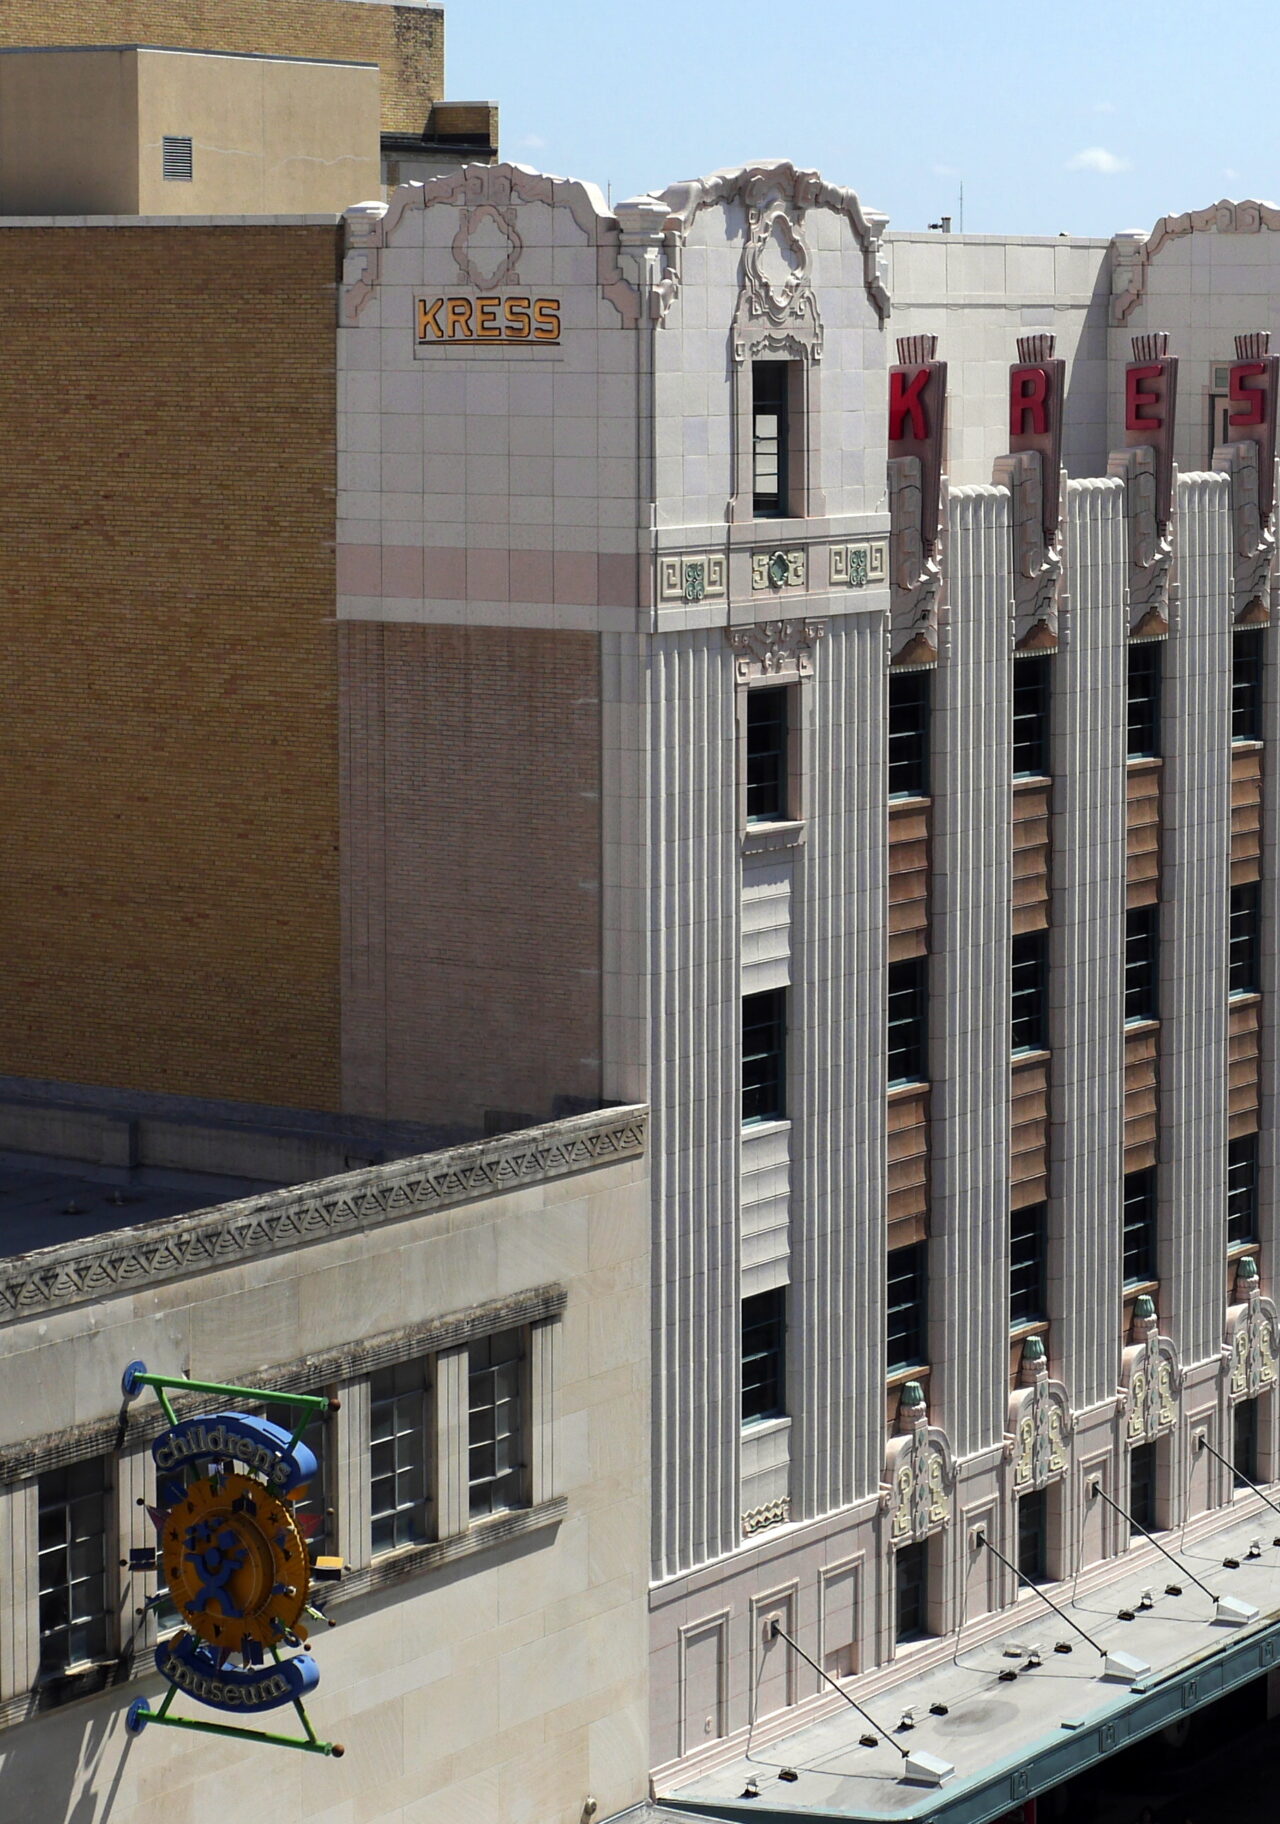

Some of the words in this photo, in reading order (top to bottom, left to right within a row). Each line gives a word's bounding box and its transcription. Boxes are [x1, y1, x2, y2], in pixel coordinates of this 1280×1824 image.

[418, 297, 560, 339] KRESS
[156, 1425, 291, 1484] children's
[165, 1656, 289, 1705] museum
